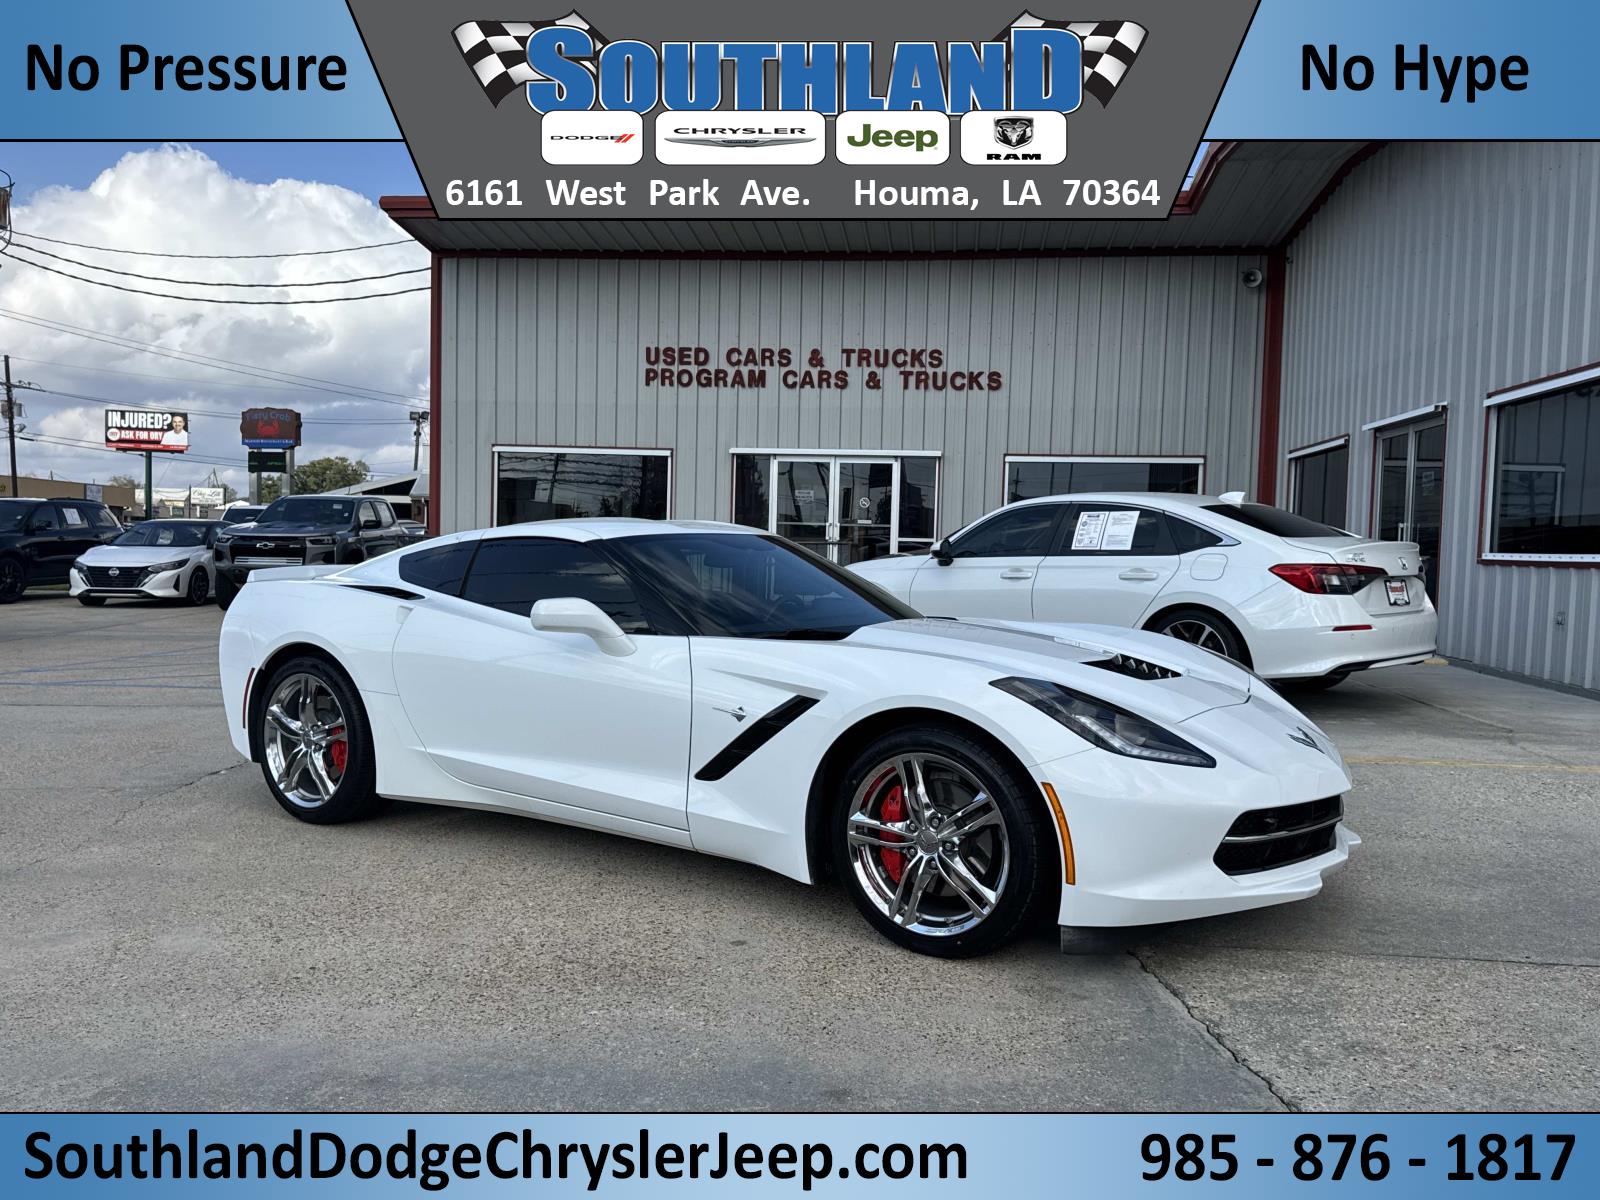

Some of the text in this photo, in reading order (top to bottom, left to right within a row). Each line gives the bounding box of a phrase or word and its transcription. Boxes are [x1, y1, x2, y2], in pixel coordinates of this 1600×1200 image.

[645, 347, 943, 368] USED CARS & TRUCKS
[645, 368, 1003, 391] PROGRAM CARS & TRUCKS
[107, 411, 172, 429] INJURED?
[121, 430, 163, 440] ASK FOR ORY
